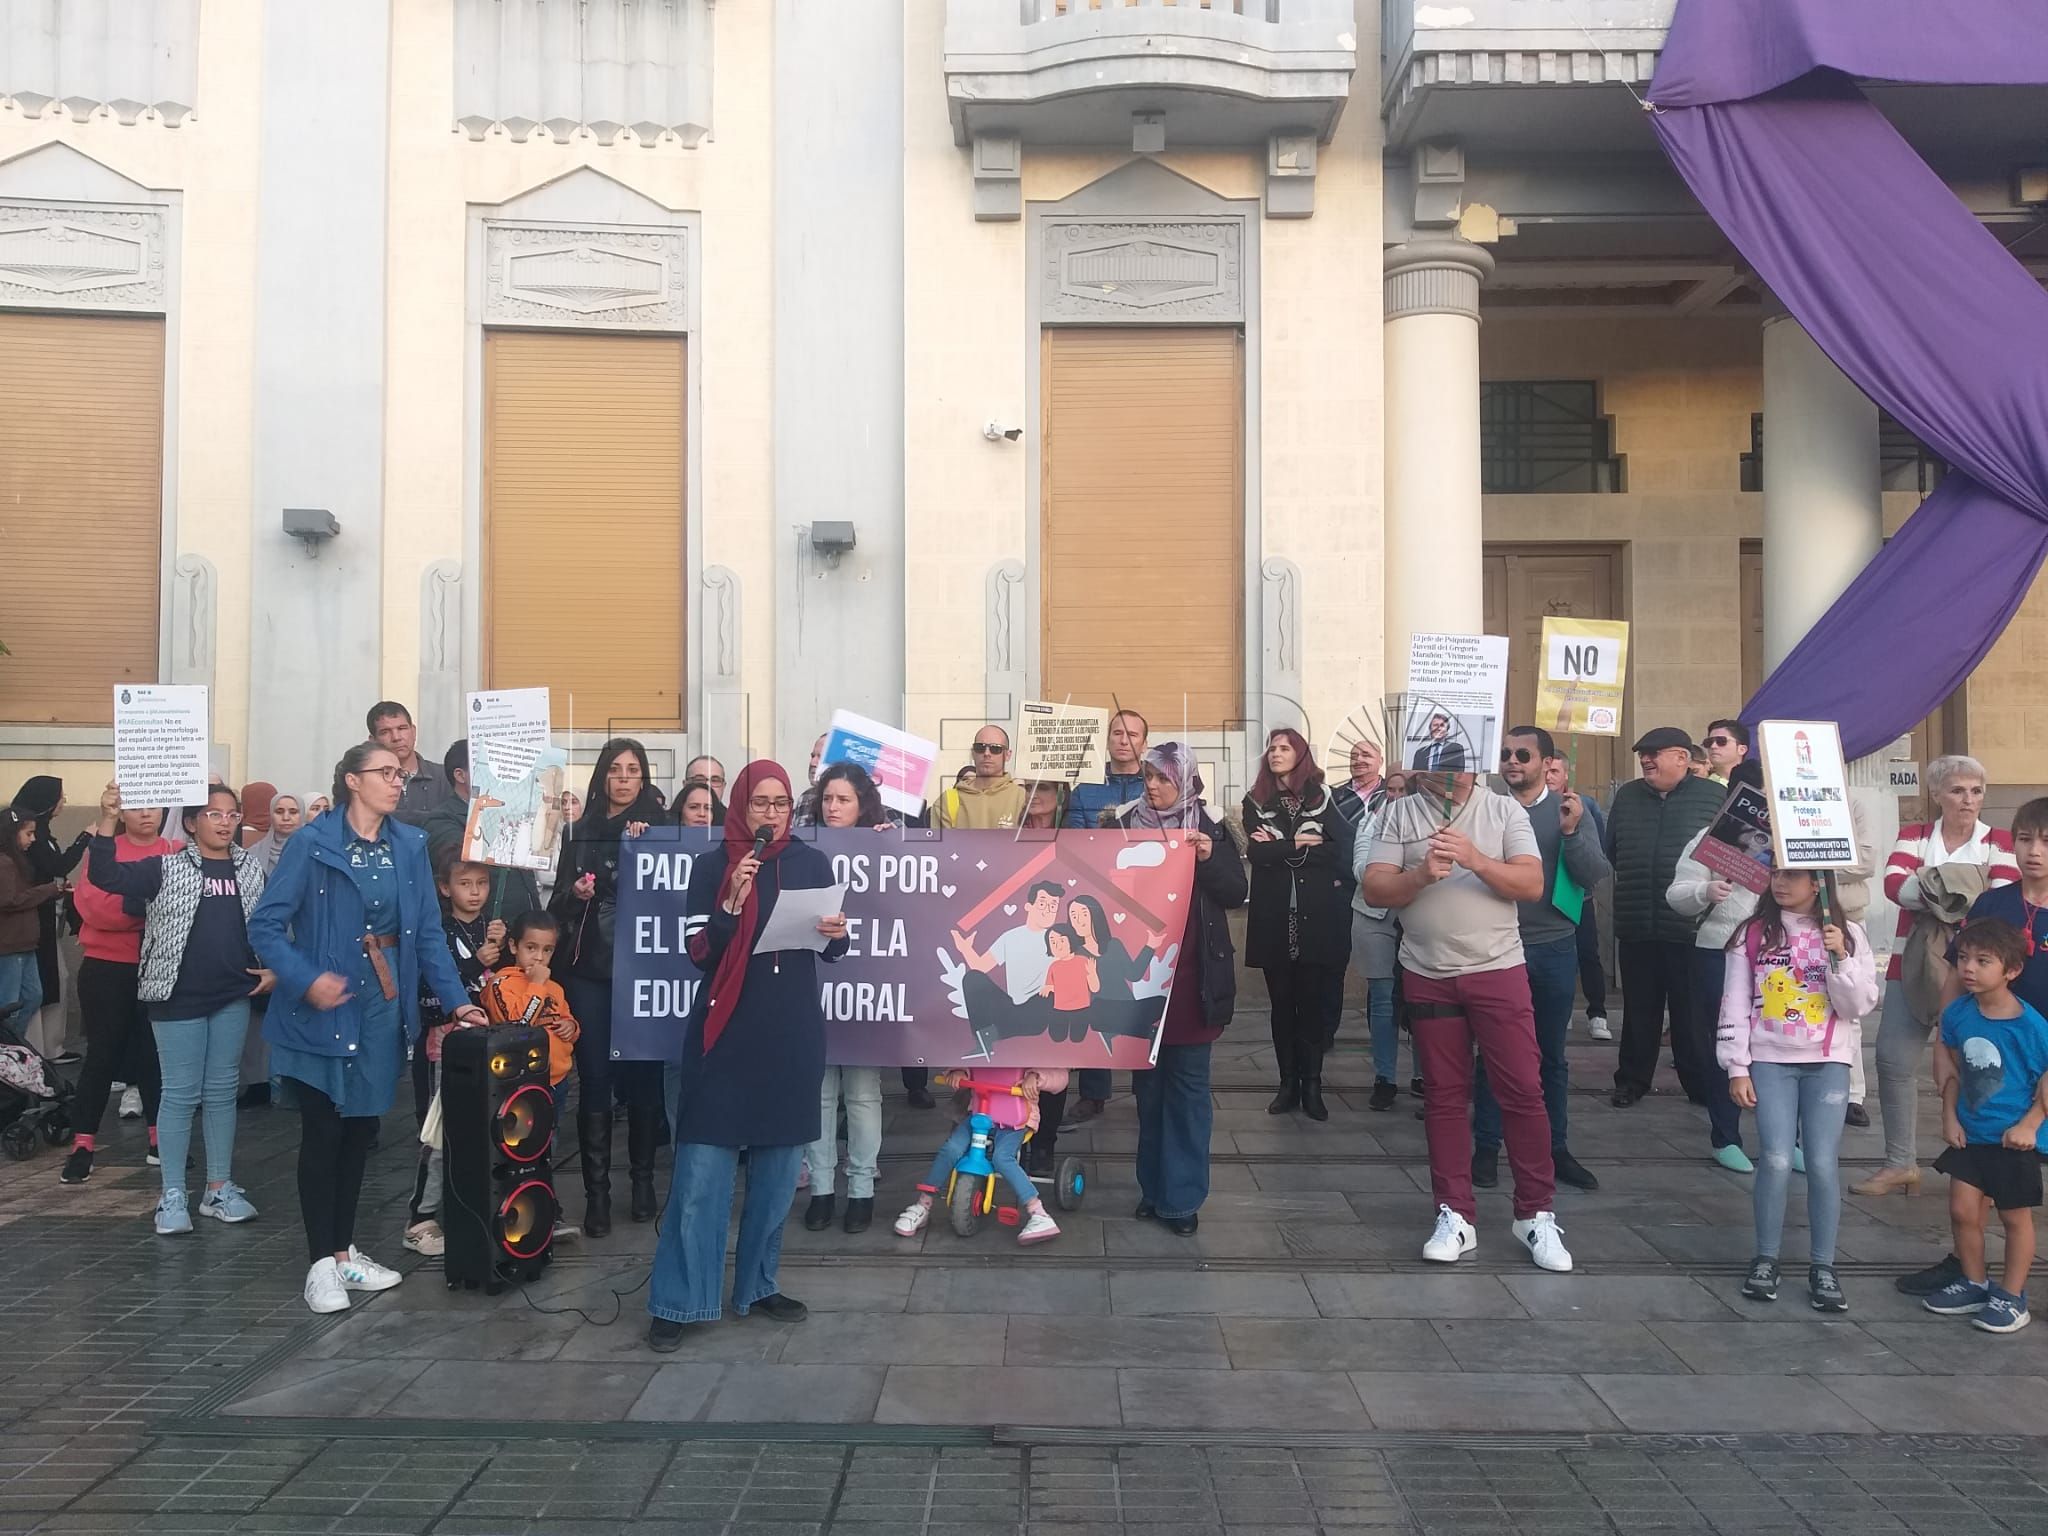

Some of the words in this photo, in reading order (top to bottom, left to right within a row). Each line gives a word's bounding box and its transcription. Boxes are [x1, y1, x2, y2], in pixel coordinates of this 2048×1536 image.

[1564, 644, 1599, 676] NO
[1467, 662, 1479, 670] que
[1039, 719, 1057, 727] PODERES
[129, 736, 152, 745] español
[154, 737, 173, 745] integre
[165, 745, 185, 753] género
[119, 781, 143, 789] produce
[161, 788, 181, 796] ningún
[1737, 797, 1769, 820] Ped
[1793, 806, 1817, 816] Protege
[1798, 816, 1810, 827] los
[1812, 814, 1832, 827] niños
[1812, 828, 1820, 836] del
[1788, 840, 1840, 850] ADOCTRINAMIENTO
[1841, 840, 1849, 849] EN
[1788, 849, 1819, 859] IDEOLOGÍA
[1820, 850, 1827, 859] DE
[1828, 848, 1850, 859] GÉNERO
[636, 853, 700, 891] PAD
[879, 855, 938, 893] POR
[635, 916, 669, 954] EL
[871, 918, 908, 957] LA
